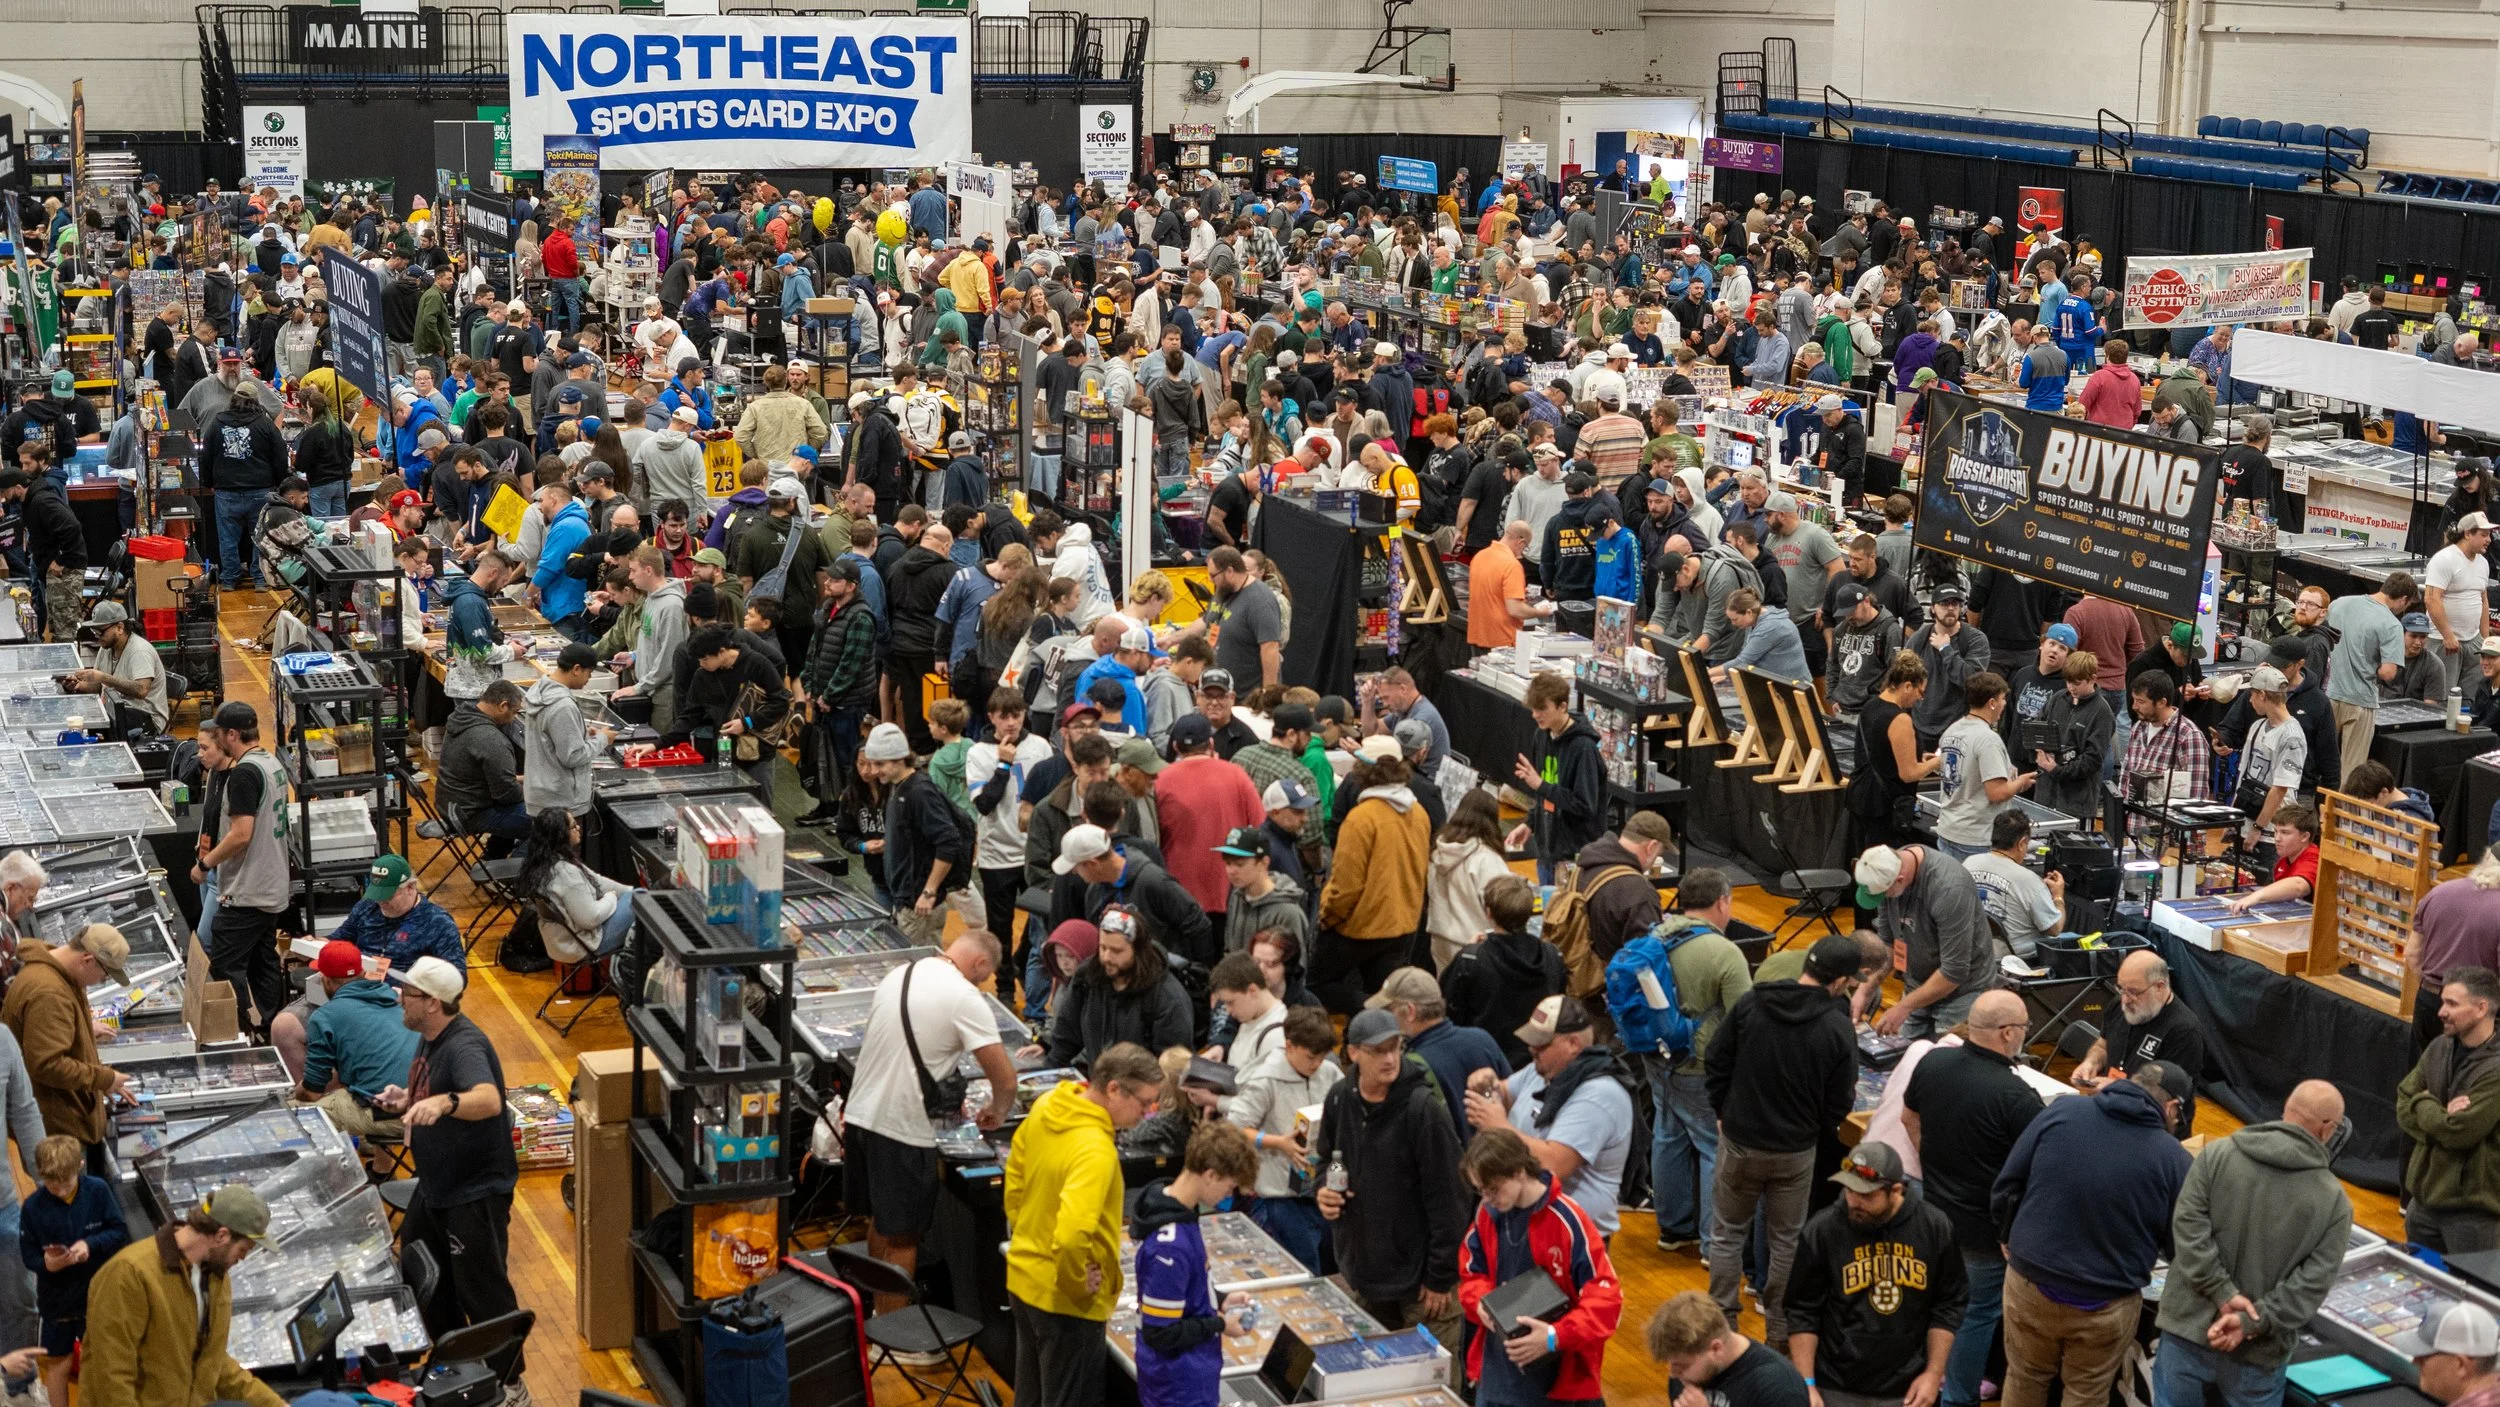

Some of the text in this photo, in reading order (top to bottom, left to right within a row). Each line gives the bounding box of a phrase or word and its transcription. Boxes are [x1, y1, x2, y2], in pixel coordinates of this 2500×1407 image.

[305, 23, 427, 48] MAINE
[523, 34, 957, 97] NORTHEAST
[591, 99, 897, 137] SPORTS CARD EXPO
[251, 136, 299, 147] SECTIONS
[1086, 132, 1127, 142] SECTIONS
[1722, 140, 1754, 156] BUYING
[965, 173, 987, 193] BUYING
[467, 205, 508, 239] BUYING CENTER
[2234, 265, 2281, 284] BUY & SELL
[331, 259, 371, 317] BUYING
[2207, 283, 2303, 304] VINTAGE SPORTS CARDS
[2126, 296, 2201, 308] PASTIME
[2201, 304, 2302, 320] www.AmericasPastime.com
[2060, 312, 2075, 338] 11
[287, 343, 312, 352] PATRIOTS
[1800, 431, 1820, 458] 11
[712, 456, 734, 468] JAMES
[713, 470, 735, 493] 23
[1947, 453, 2028, 498] ROSSICARDSRI
[2037, 427, 2200, 518] BUYING
[2293, 470, 2307, 479] ACCEPT
[1400, 483, 1416, 497] 40
[1963, 483, 1978, 491] BUYING
[2034, 504, 2056, 517] BASEBALL
[2061, 512, 2089, 525] BASKETBALL
[2093, 519, 2116, 532] FOOTBALL
[2121, 526, 2140, 537] HOCKEY
[2143, 532, 2161, 543] SOCCER
[2037, 490, 2190, 539] SPORTS CARDS ALL SPORTS ALL YEARS
[2339, 512, 2365, 527] Paying
[2366, 516, 2381, 528] Top
[1953, 533, 1971, 545] BOBBY
[2037, 530, 2071, 545] CASH PAYMENTS
[2093, 544, 2104, 555] FAST
[2107, 548, 2121, 558] EASY
[2056, 562, 2100, 581] @ROSSICARDSRI
[2148, 560, 2163, 571] LOCAL
[2167, 564, 2187, 577] TRUSTED
[2124, 581, 2170, 600] @ROSSICARDSRI
[1839, 632, 1875, 655] CELTICS
[733, 1252, 768, 1266] helps
